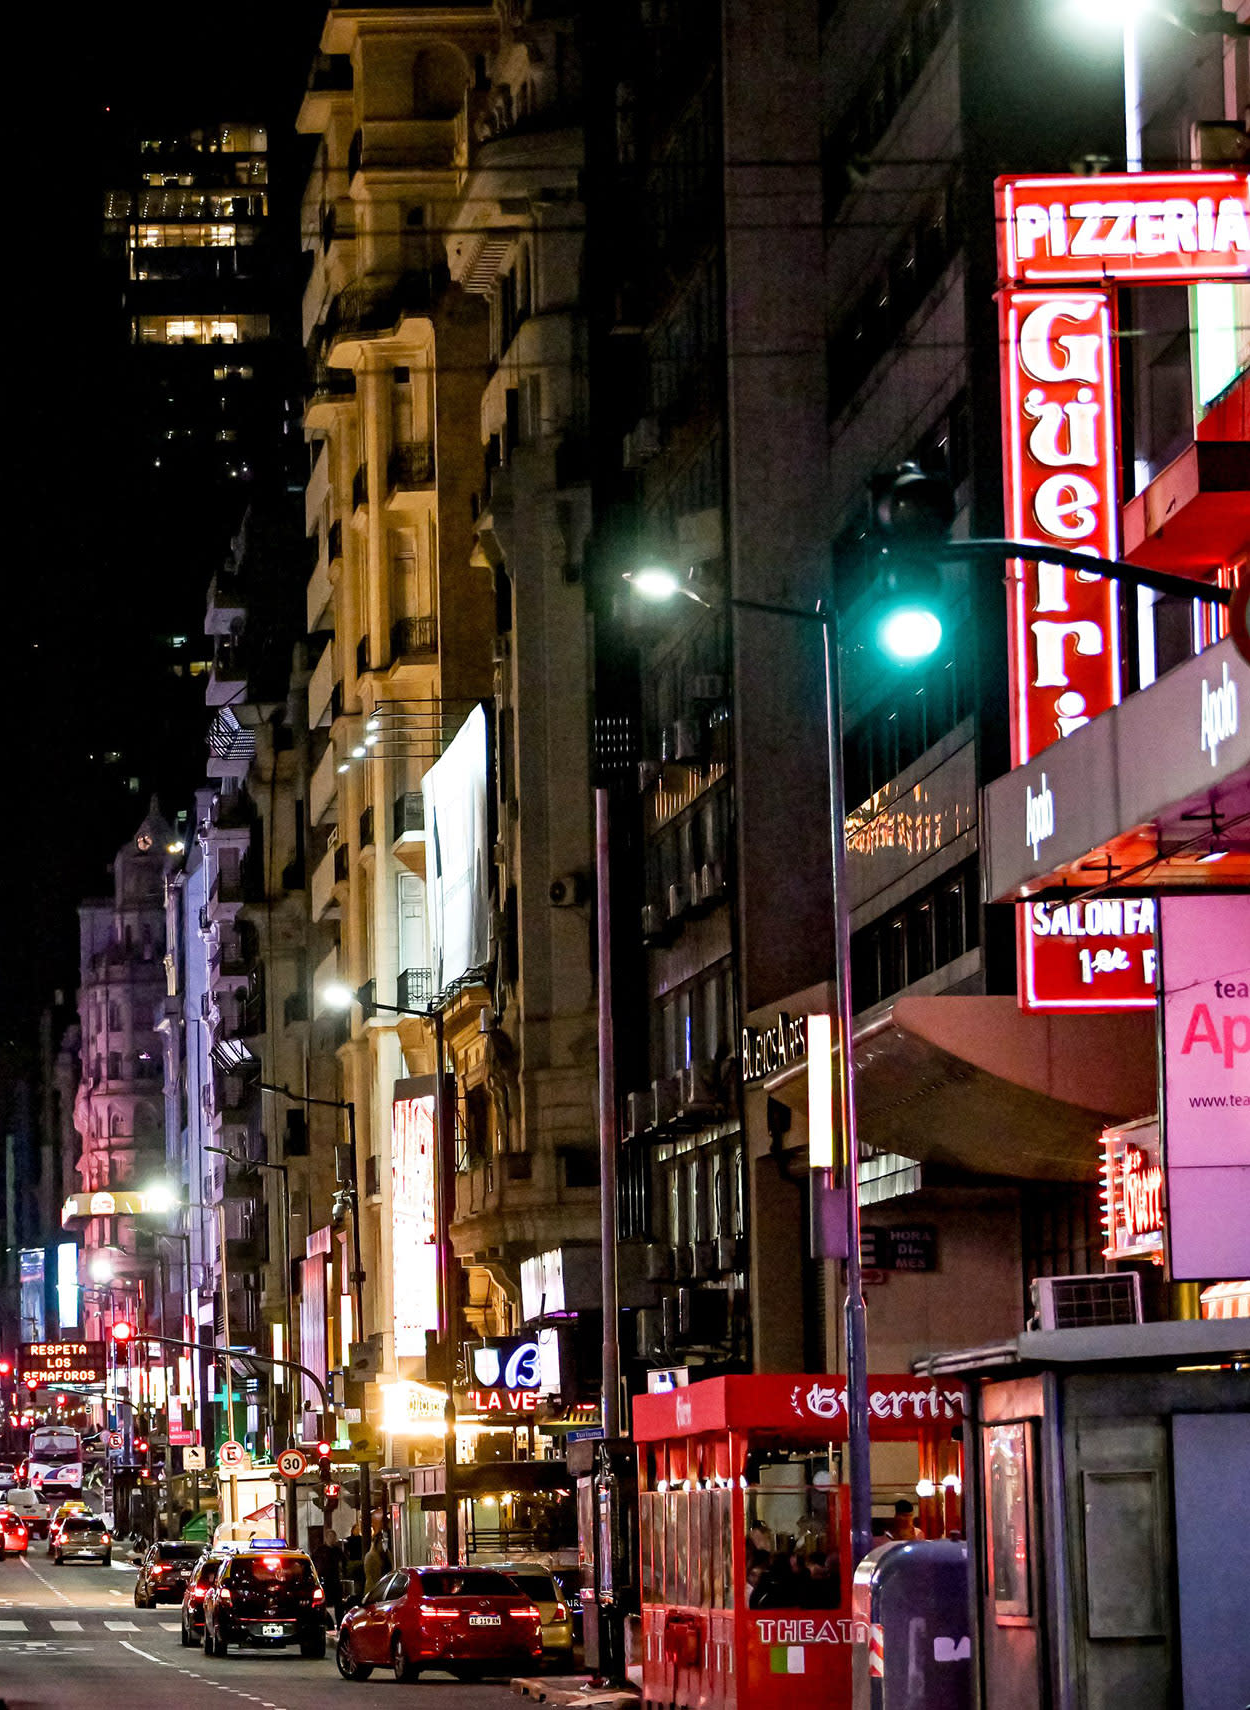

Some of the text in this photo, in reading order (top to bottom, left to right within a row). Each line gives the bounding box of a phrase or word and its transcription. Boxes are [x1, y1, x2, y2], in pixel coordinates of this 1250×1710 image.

[1015, 197, 1250, 259] PIZZERIA
[1200, 661, 1248, 767] Apolo
[1025, 772, 1055, 861] Apolo
[1032, 900, 1123, 936] SALON
[1181, 1003, 1250, 1069] Ap
[30, 1344, 87, 1356] RESPETA
[46, 1358, 72, 1369] LOS
[23, 1370, 96, 1382] SEMAFOROS
[806, 1383, 963, 1418] Gerrin
[283, 1458, 300, 1470] 30
[480, 1617, 491, 1625] 119
[756, 1619, 853, 1643] THEAT
